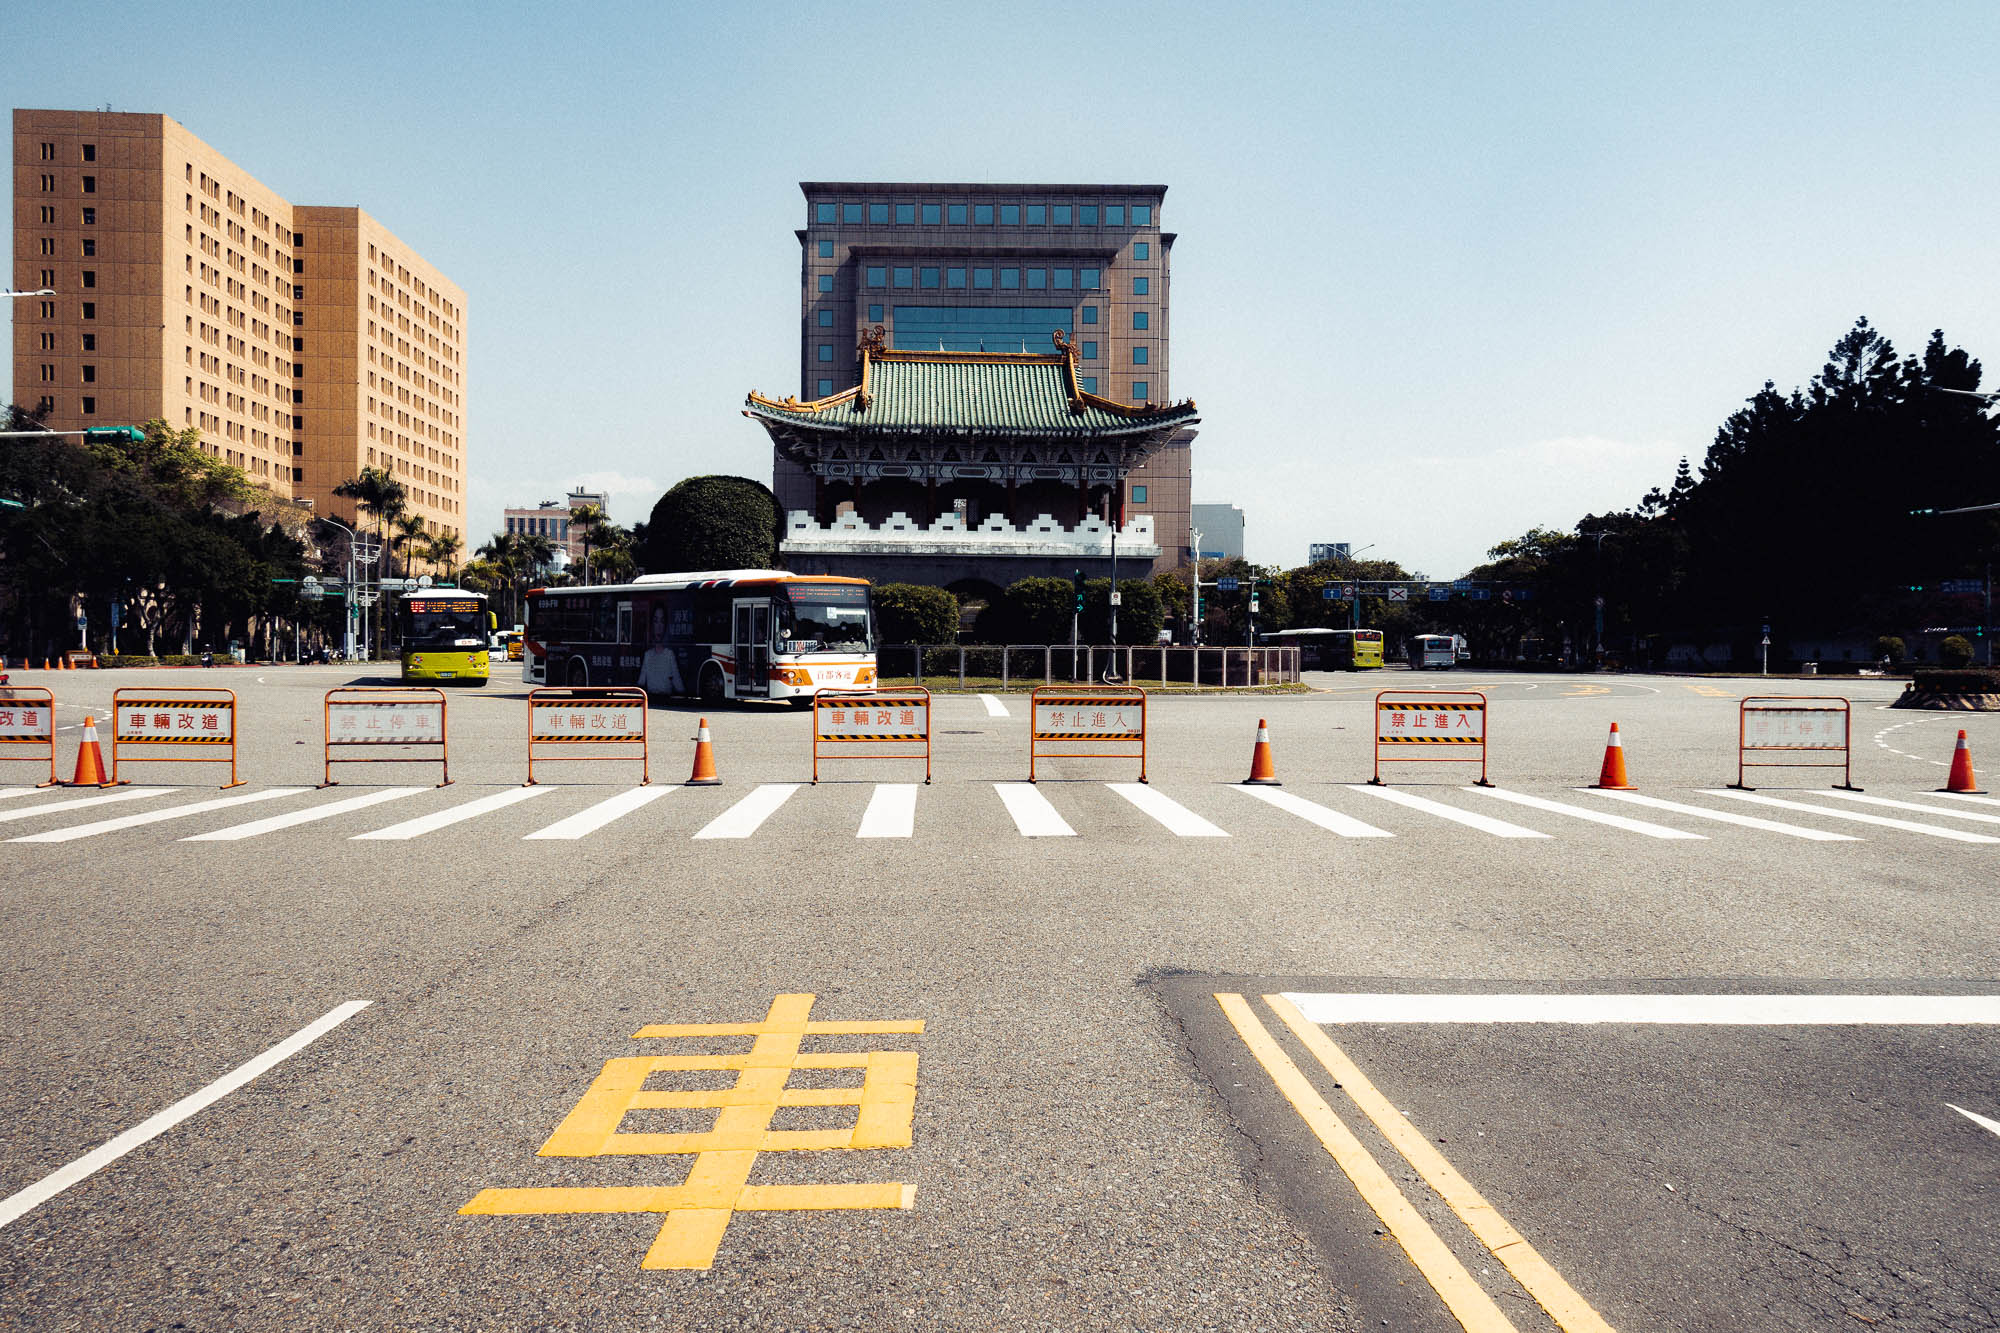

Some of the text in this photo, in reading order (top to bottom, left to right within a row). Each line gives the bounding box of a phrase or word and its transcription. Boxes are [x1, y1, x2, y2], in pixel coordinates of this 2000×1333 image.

[0, 711, 38, 727] 改道
[130, 713, 219, 730] 車輛改道
[340, 714, 431, 729] 禁止停車
[547, 713, 628, 730] 車輛改道
[831, 710, 915, 726] 車輛改道
[1049, 711, 1127, 728] 禁止進入
[1391, 712, 1471, 729] 禁止進入
[458, 993, 925, 1270] 車
